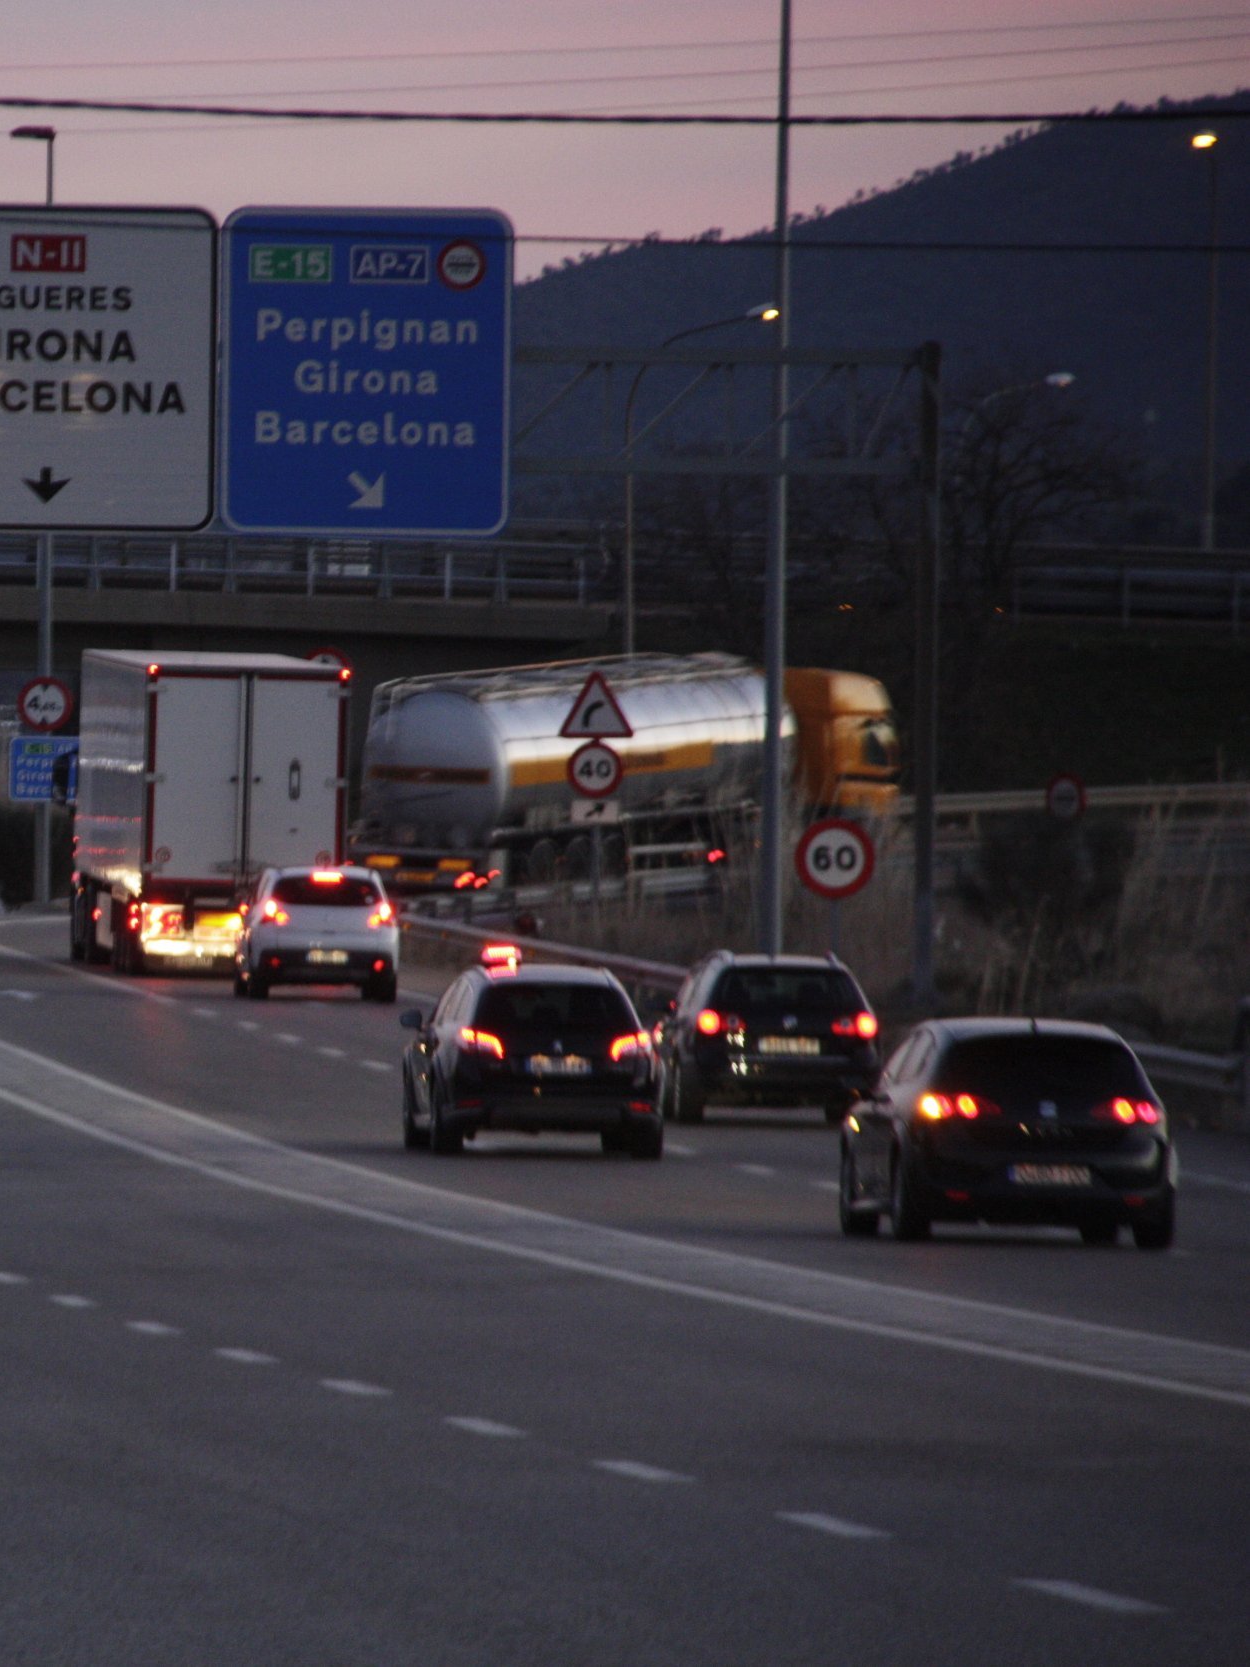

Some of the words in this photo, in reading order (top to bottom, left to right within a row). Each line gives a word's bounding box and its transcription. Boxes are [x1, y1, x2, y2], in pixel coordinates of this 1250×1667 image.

[253, 250, 327, 278] E-15
[355, 252, 424, 278] AP-7
[256, 309, 478, 351] Perpignan
[294, 360, 438, 395] Girona
[255, 411, 475, 446] Barcelona
[578, 759, 611, 779] 40
[812, 845, 857, 872] 60
